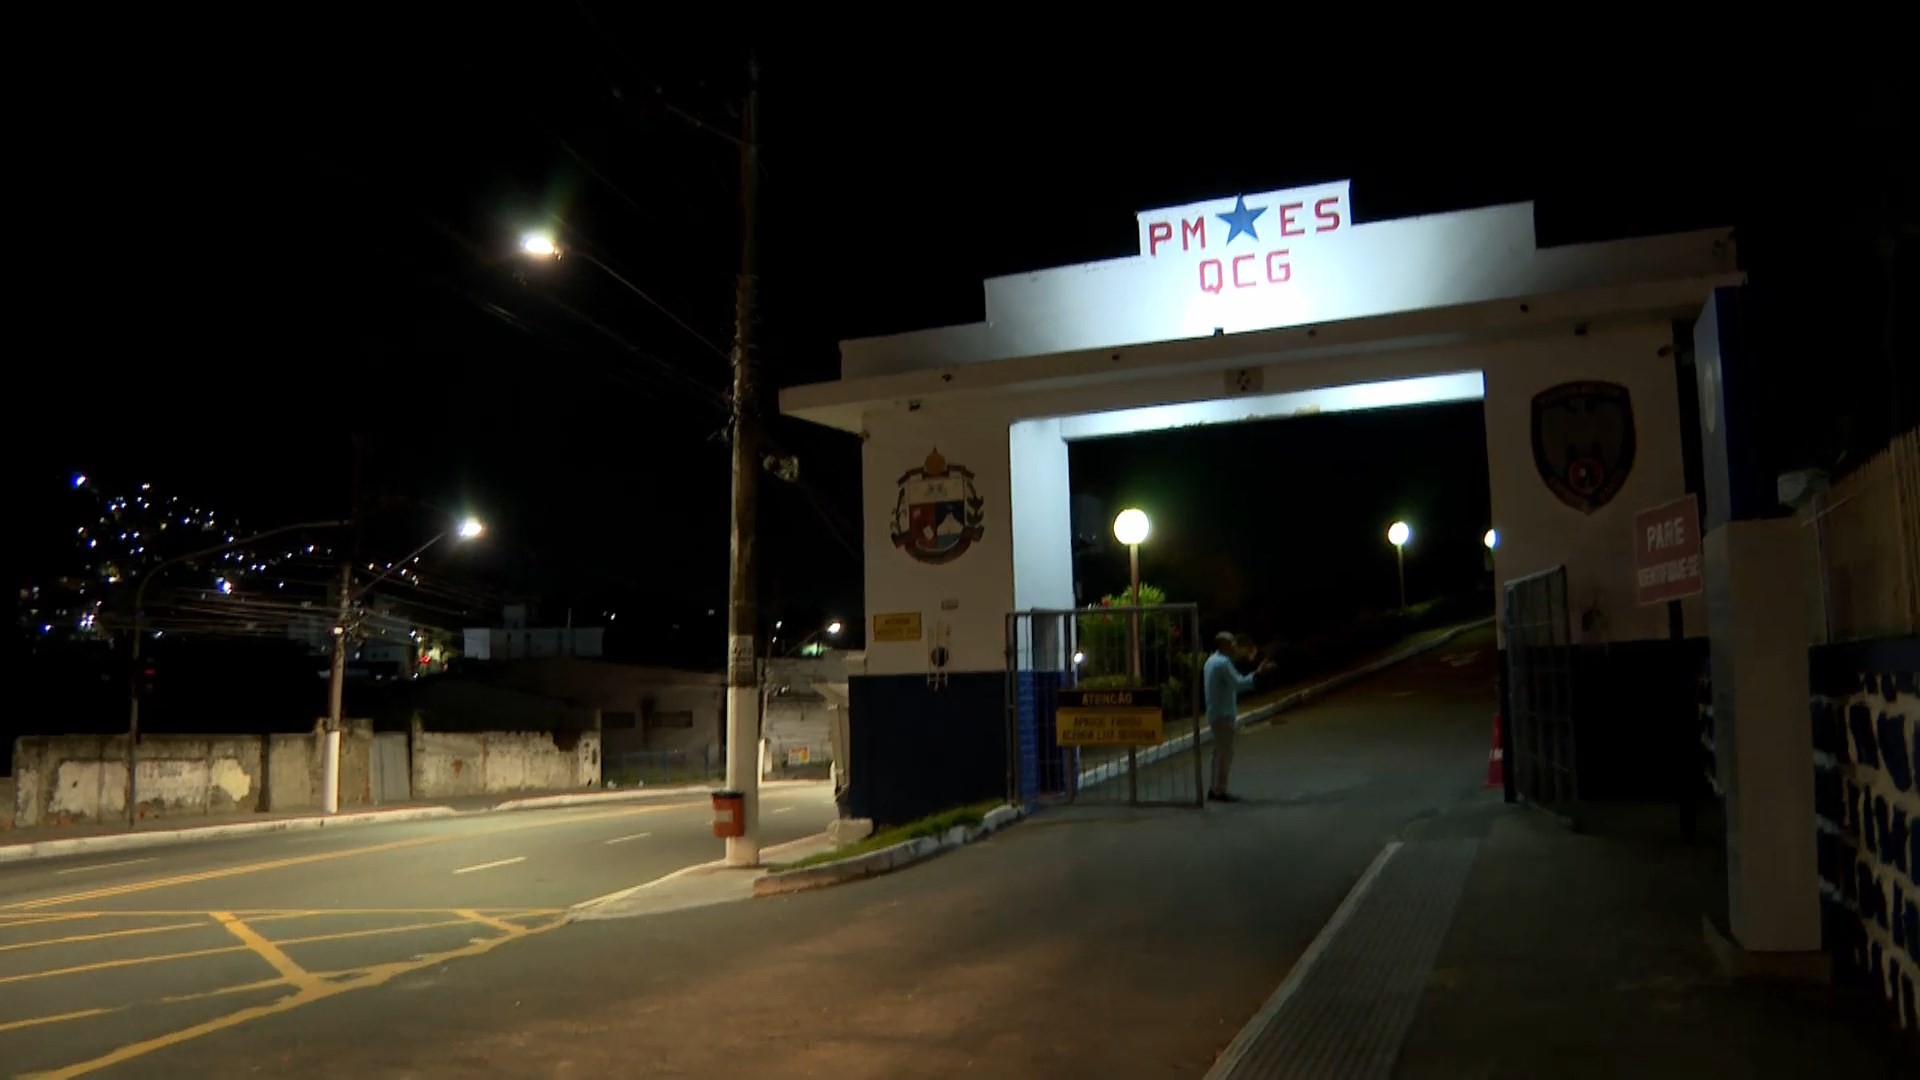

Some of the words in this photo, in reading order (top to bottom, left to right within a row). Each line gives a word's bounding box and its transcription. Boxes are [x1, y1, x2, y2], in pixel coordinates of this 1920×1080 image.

[1149, 216, 1207, 257] PM
[1279, 197, 1341, 237] ES
[1199, 248, 1292, 294] QCG
[1646, 516, 1685, 552] PARE
